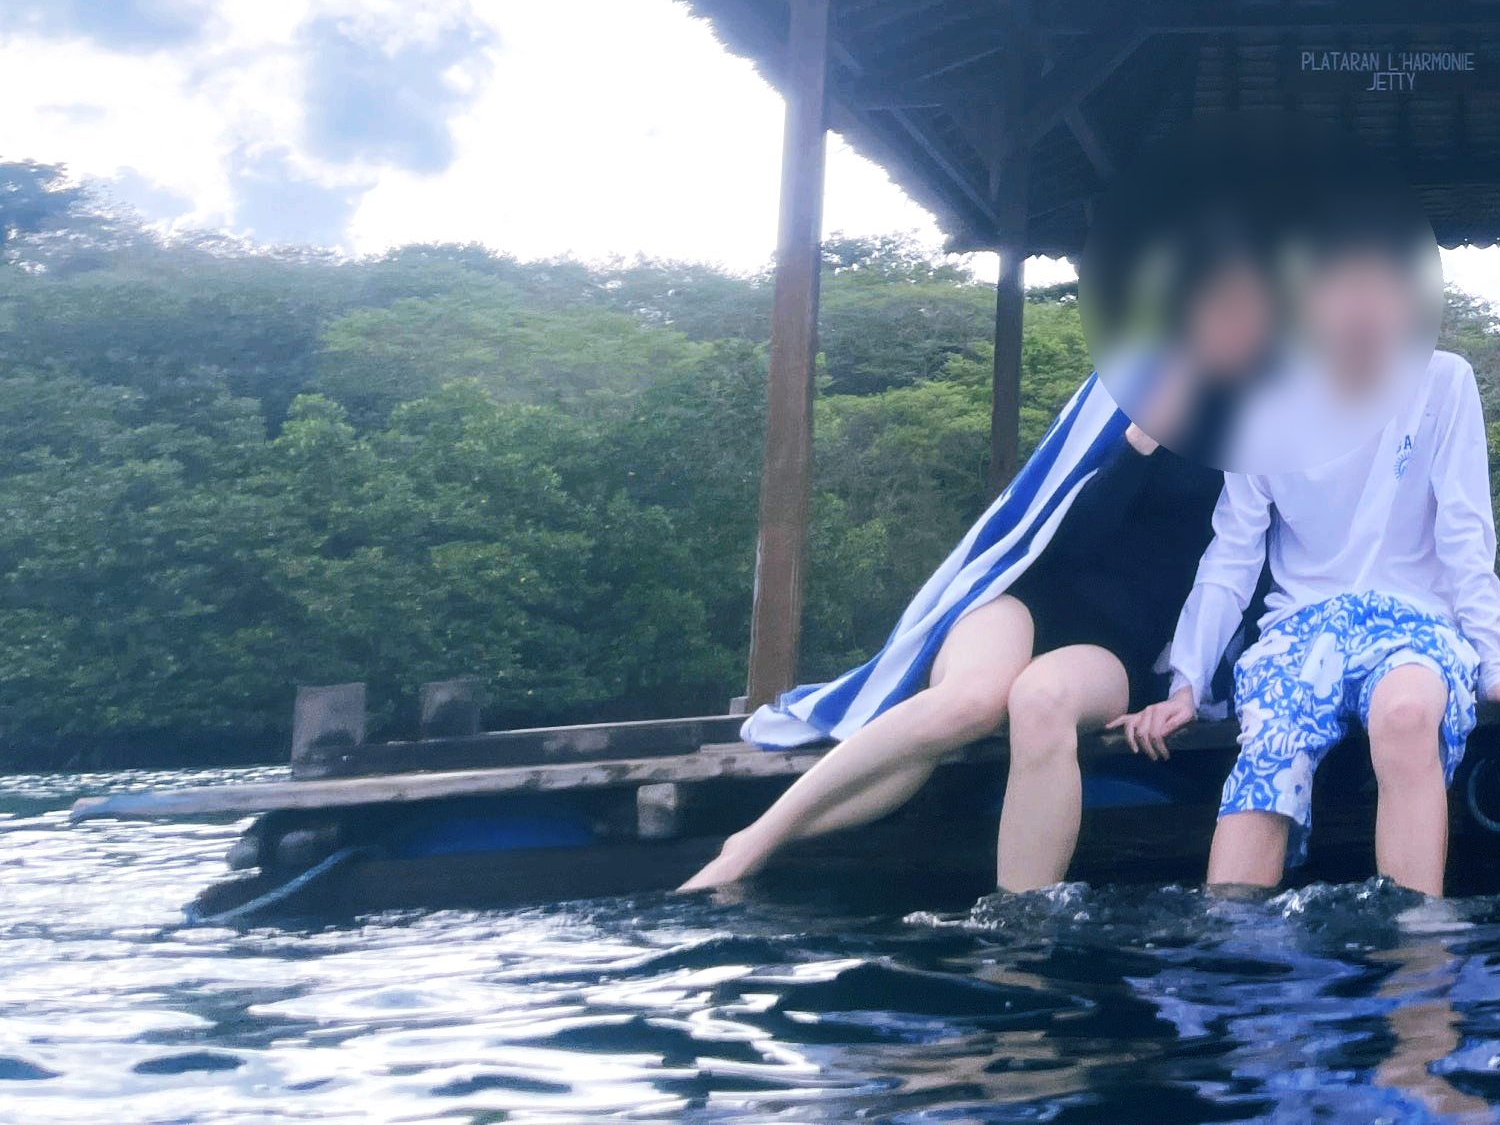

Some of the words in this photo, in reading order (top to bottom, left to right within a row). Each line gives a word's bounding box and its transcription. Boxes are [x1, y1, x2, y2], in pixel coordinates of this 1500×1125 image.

[1301, 51, 1380, 72] PLATARAN
[1388, 52, 1475, 72] L'HARMONIE
[1365, 72, 1416, 91] JETTY
